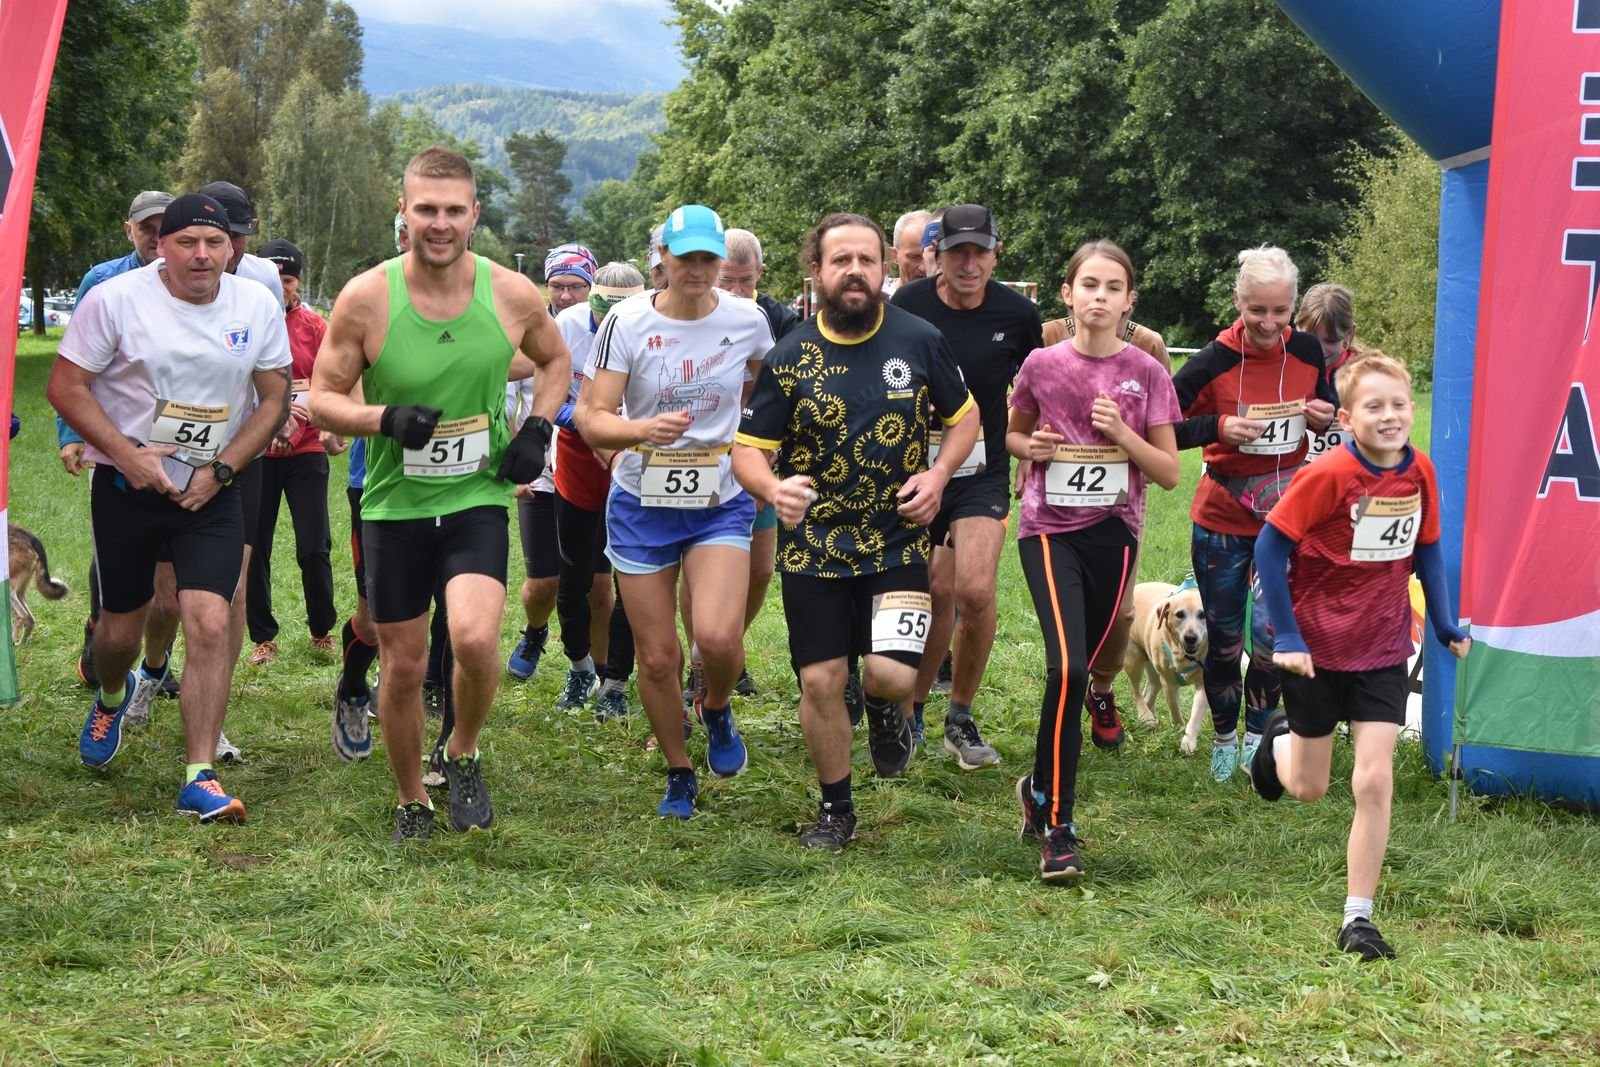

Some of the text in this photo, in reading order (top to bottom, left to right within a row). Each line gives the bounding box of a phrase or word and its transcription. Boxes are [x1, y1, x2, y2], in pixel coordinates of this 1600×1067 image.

[175, 422, 212, 447] 54
[1260, 419, 1290, 443] 41
[1313, 433, 1341, 452] 59
[430, 437, 465, 464] 51
[664, 469, 700, 494] 53
[1067, 466, 1106, 492] 42
[1380, 517, 1414, 545] 49
[897, 612, 927, 638] 55
